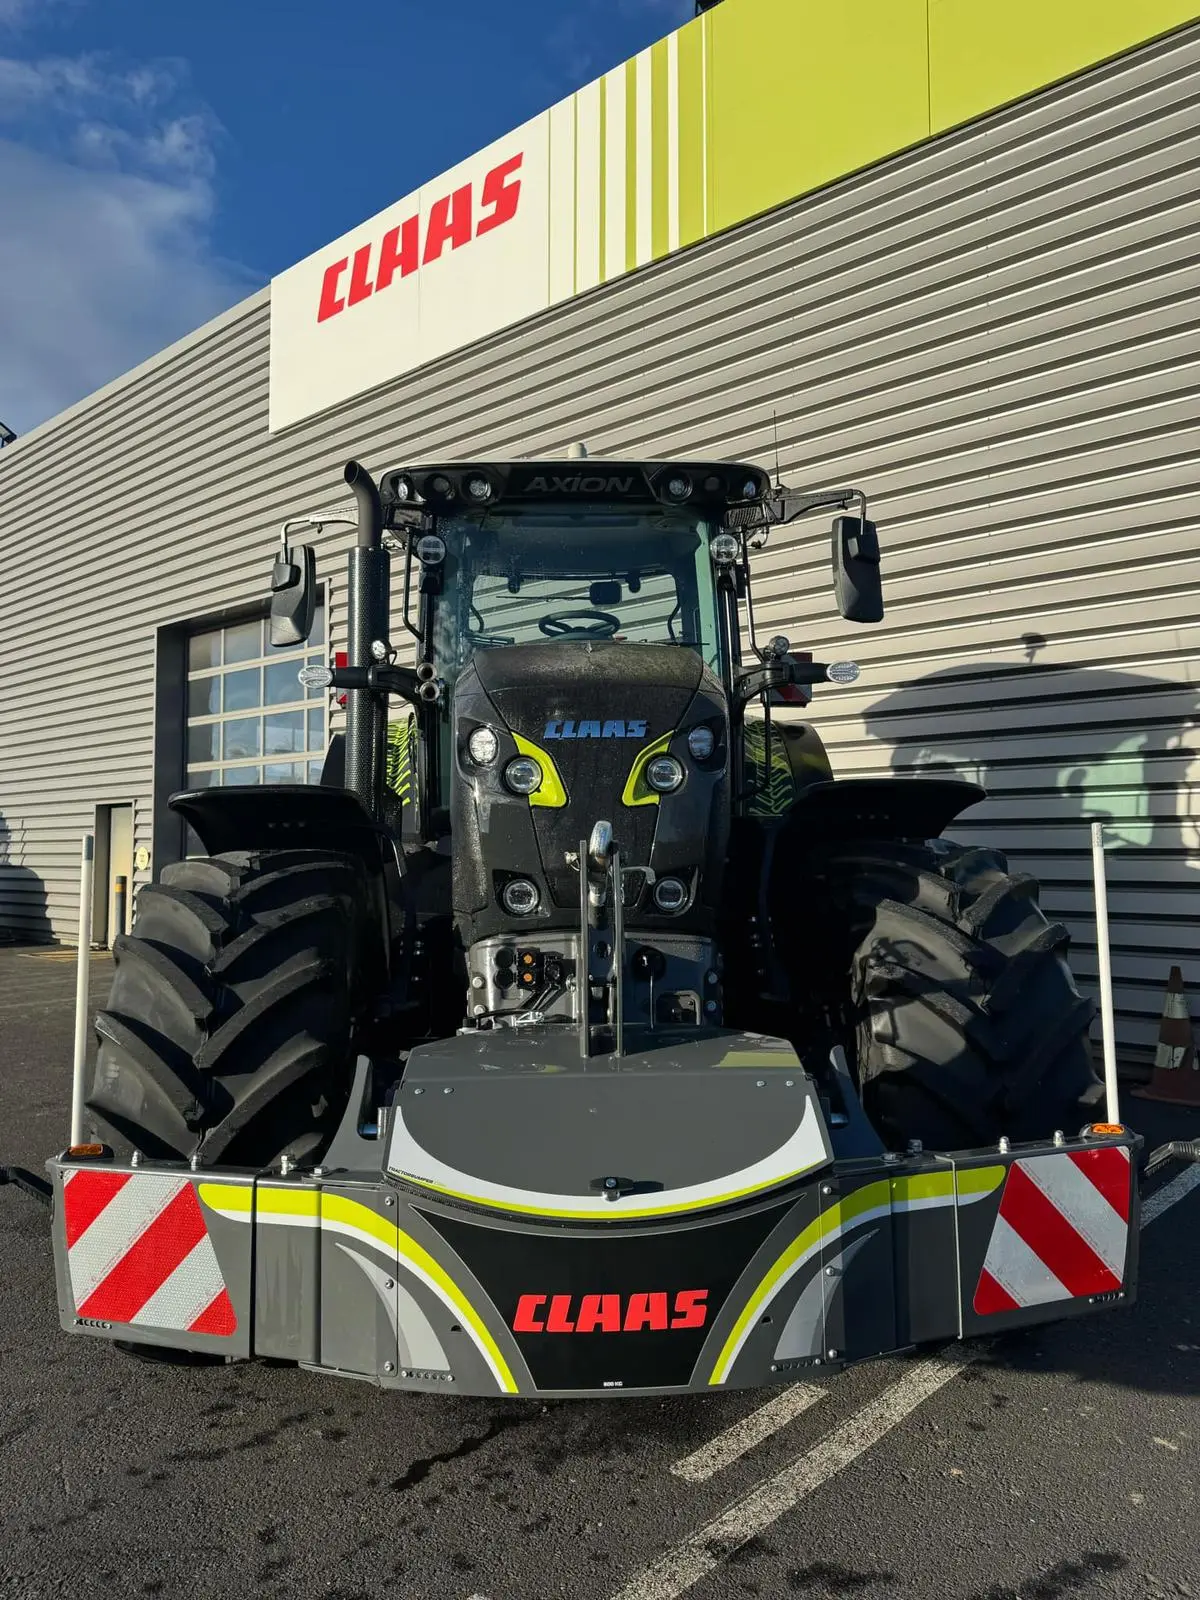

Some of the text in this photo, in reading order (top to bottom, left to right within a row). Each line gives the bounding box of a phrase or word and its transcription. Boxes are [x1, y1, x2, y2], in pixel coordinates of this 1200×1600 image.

[317, 151, 524, 323] CLAAS
[522, 471, 635, 492] AXION
[543, 719, 648, 740] CLAAS
[513, 1289, 709, 1332] CLAAS
